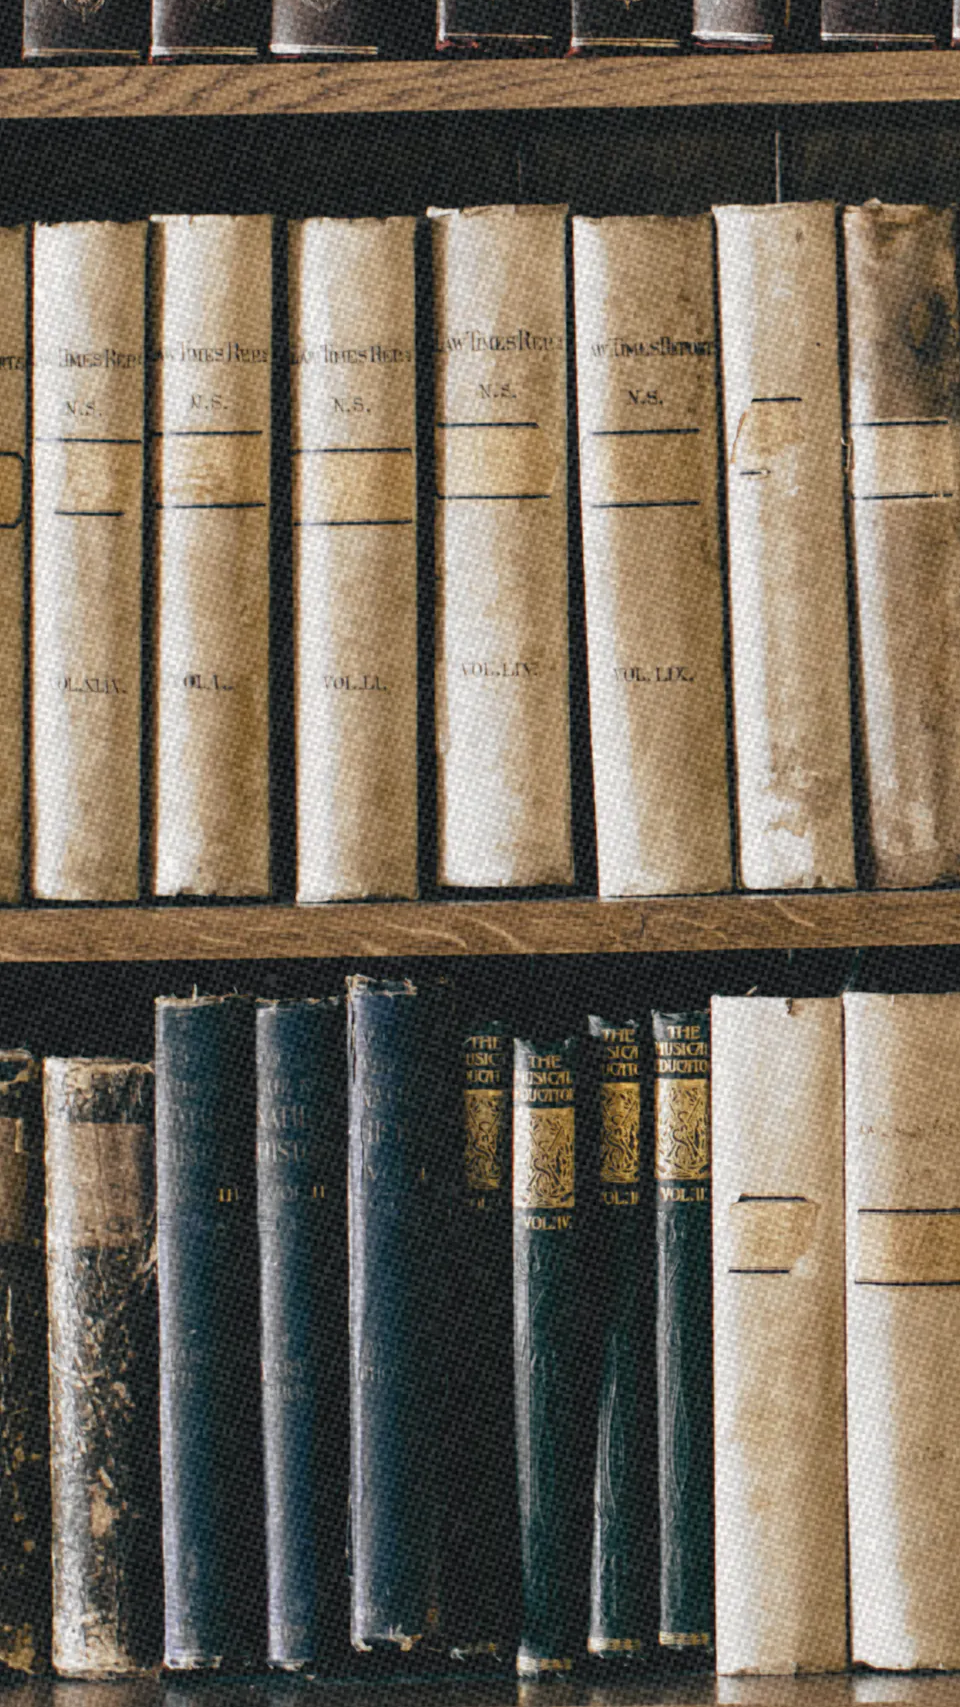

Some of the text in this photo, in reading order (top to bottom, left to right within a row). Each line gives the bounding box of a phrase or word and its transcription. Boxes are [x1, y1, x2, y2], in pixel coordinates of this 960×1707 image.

[627, 389, 664, 406] N.S.
[601, 1028, 636, 1043] THE
[666, 1025, 700, 1040] THE
[528, 1055, 562, 1069] THE
